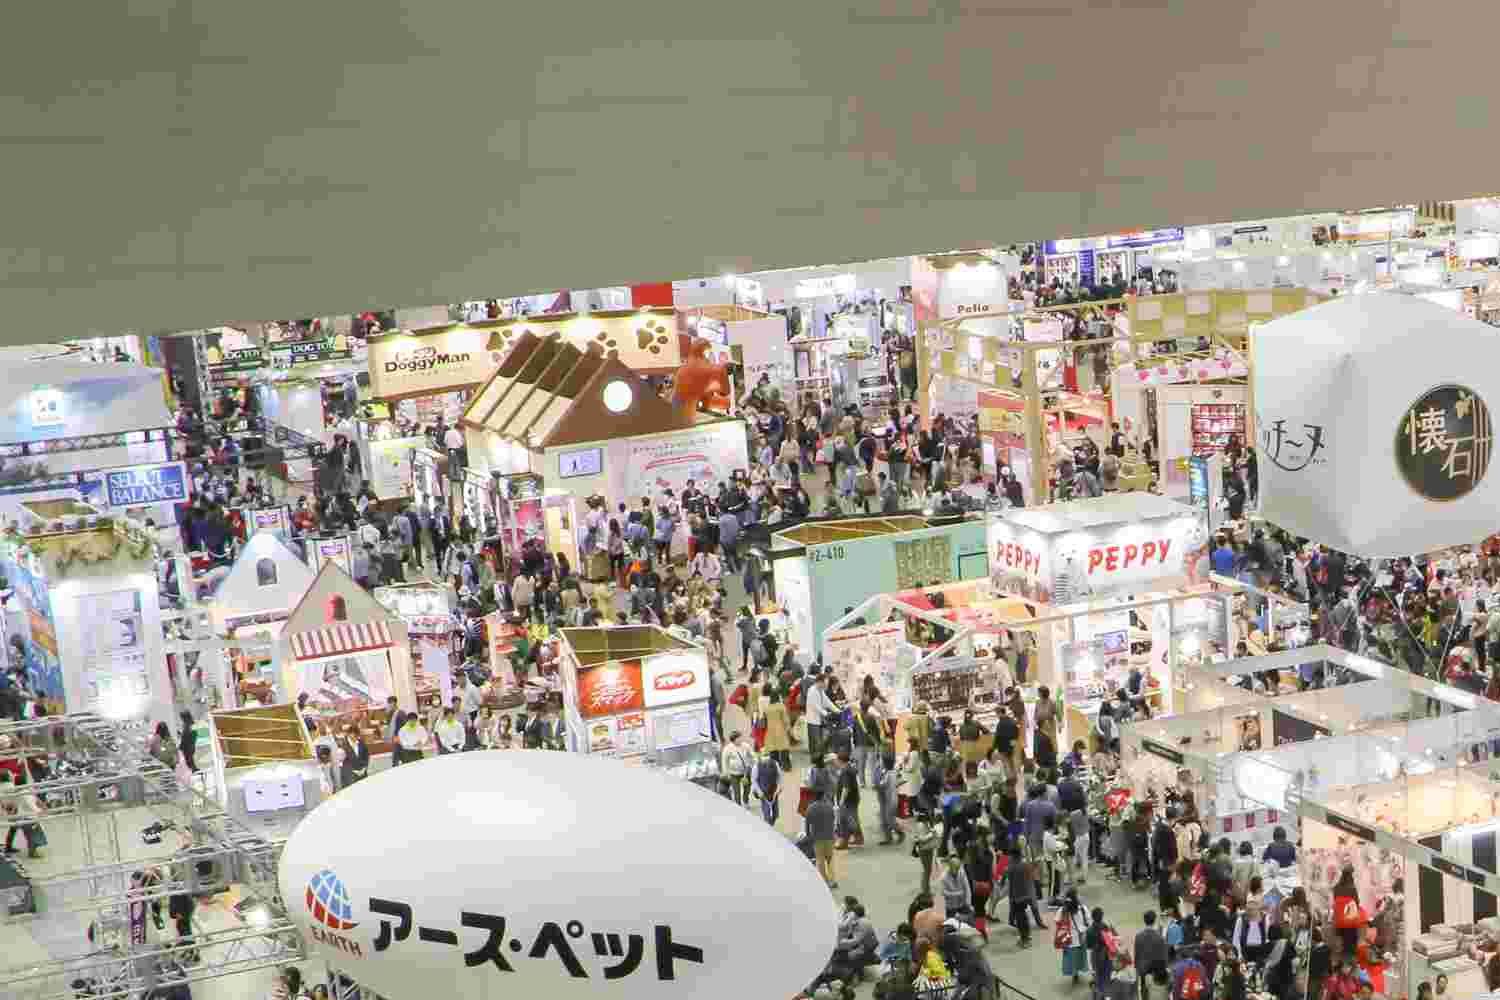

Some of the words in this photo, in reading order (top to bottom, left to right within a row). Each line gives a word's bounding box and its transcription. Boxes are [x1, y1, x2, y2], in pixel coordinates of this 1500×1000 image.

[384, 349, 472, 374] DoggyMan
[996, 540, 1041, 575] PEPPY
[1086, 539, 1172, 577] PEPPY
[310, 925, 363, 957] EARTH
[368, 896, 704, 982] アース・ペット
